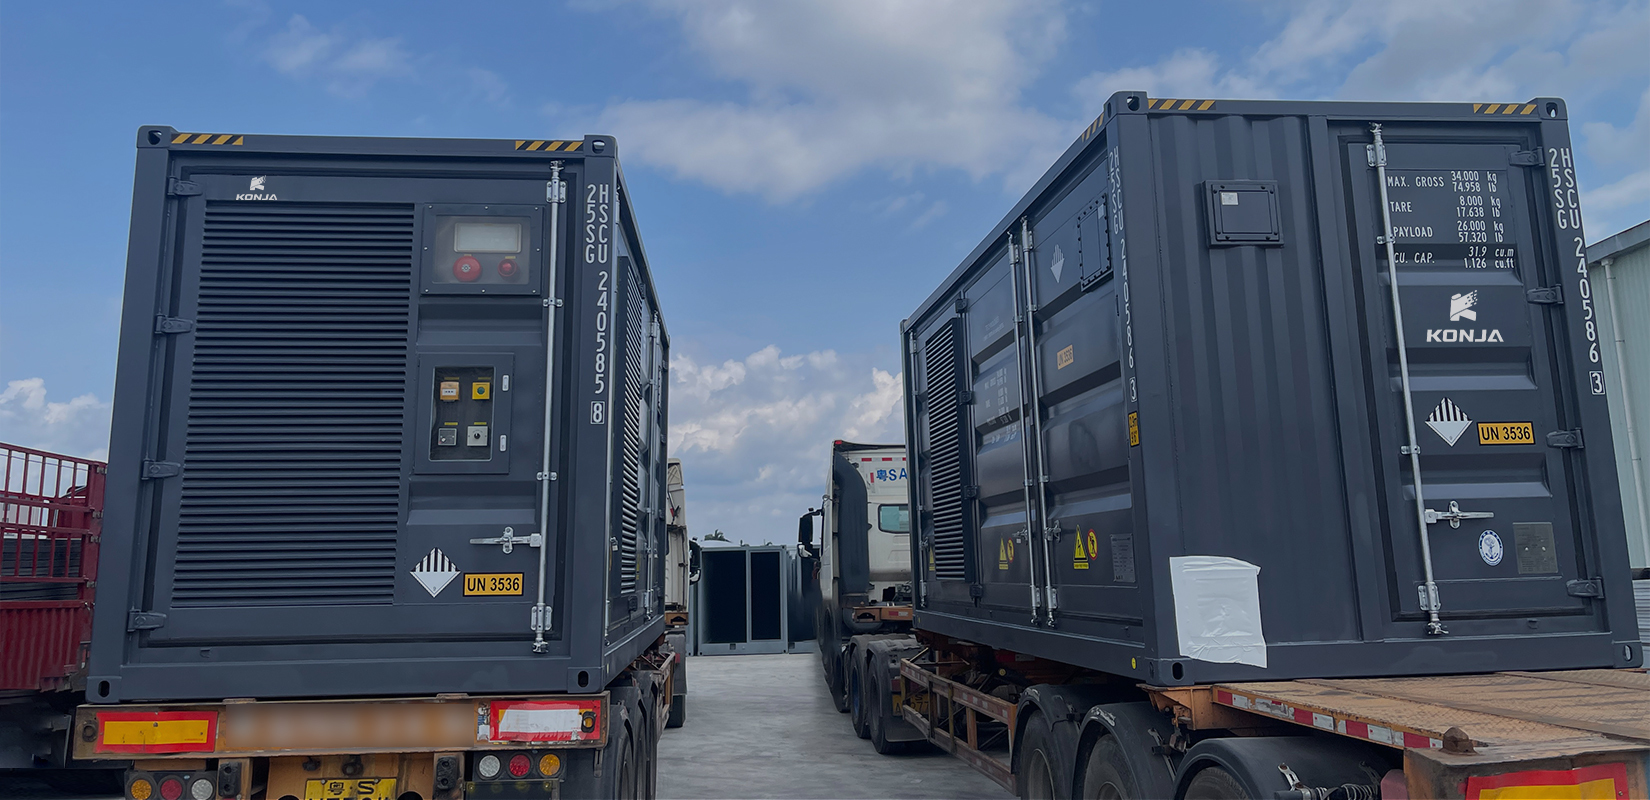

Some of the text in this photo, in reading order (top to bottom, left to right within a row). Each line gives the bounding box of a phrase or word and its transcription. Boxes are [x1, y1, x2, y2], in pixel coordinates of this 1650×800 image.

[1387, 170, 1497, 187] MAX. GROSS 34.000 kg
[1109, 152, 1119, 234] 25SG
[1452, 182, 1497, 193] 74.958 lb
[1549, 148, 1567, 230] 25SG
[1390, 195, 1501, 212] TARE 8.000 kg
[1456, 207, 1501, 218] 17.638 lb
[585, 184, 597, 264] 25SG
[1393, 220, 1504, 238] PAYLOAD 26.000 kg
[1459, 232, 1504, 243] 57.320 lb
[1114, 146, 1124, 231] HSCU
[1120, 238, 1134, 369] 240586
[1394, 246, 1515, 264] CU. CAP. 31.9 cu.m
[1463, 257, 1515, 269] 1.126 cu.ft
[1560, 148, 1603, 393] HSCU 240586 3
[592, 184, 609, 423] HSCU 240585 8
[1426, 329, 1504, 343] KONJA
[1481, 426, 1531, 441] UN 3536
[467, 577, 520, 592] UN 3536
